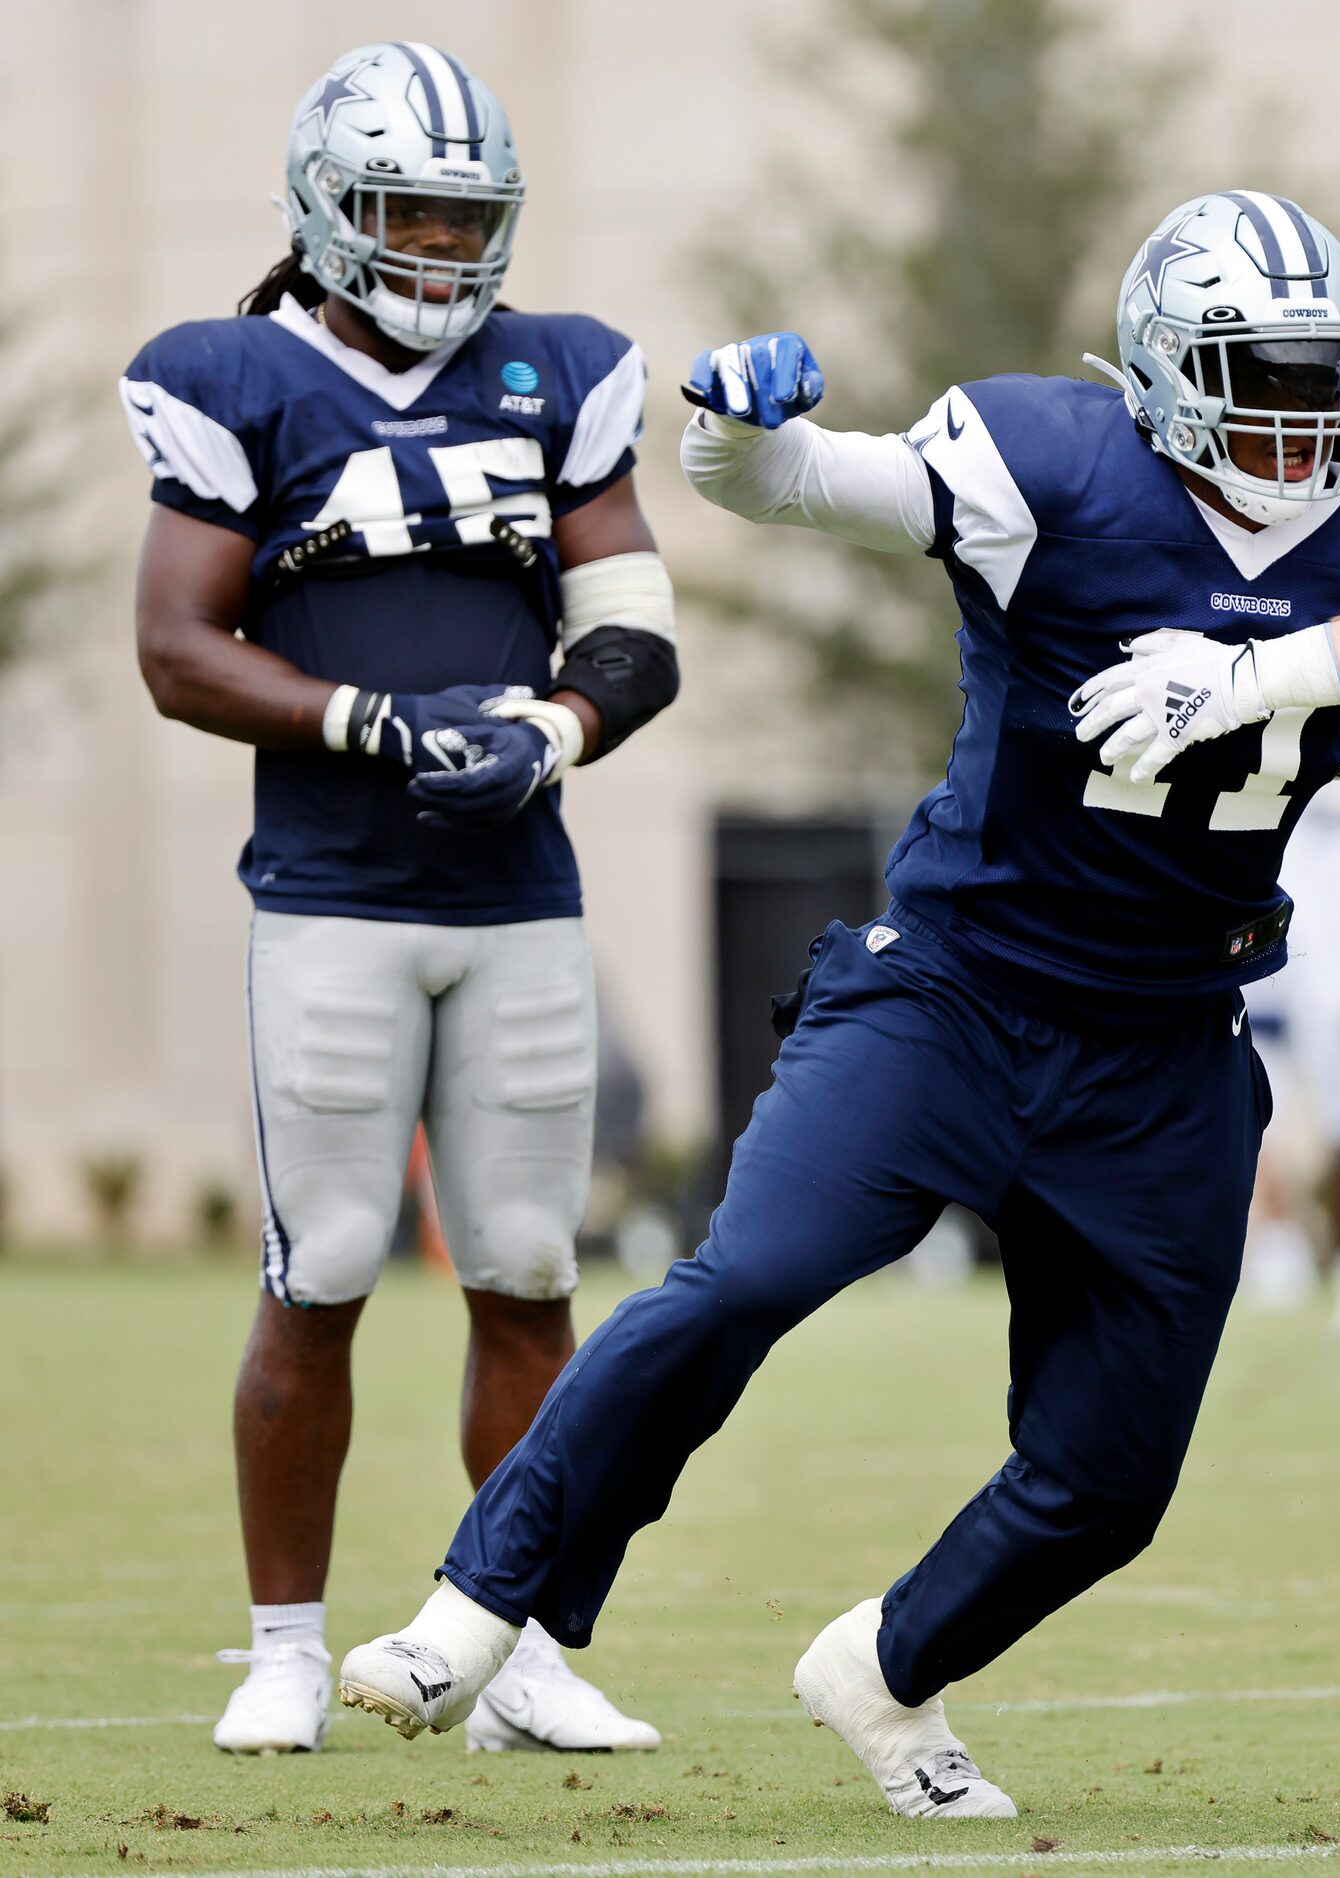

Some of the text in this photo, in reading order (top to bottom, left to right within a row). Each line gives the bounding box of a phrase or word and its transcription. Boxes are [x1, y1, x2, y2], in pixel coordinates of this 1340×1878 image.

[1282, 309, 1328, 318] COWBOYS
[499, 395, 545, 416] AT&T
[301, 437, 552, 558] 45
[1211, 592, 1291, 616] COWBOYS
[1169, 688, 1211, 739] adidas
